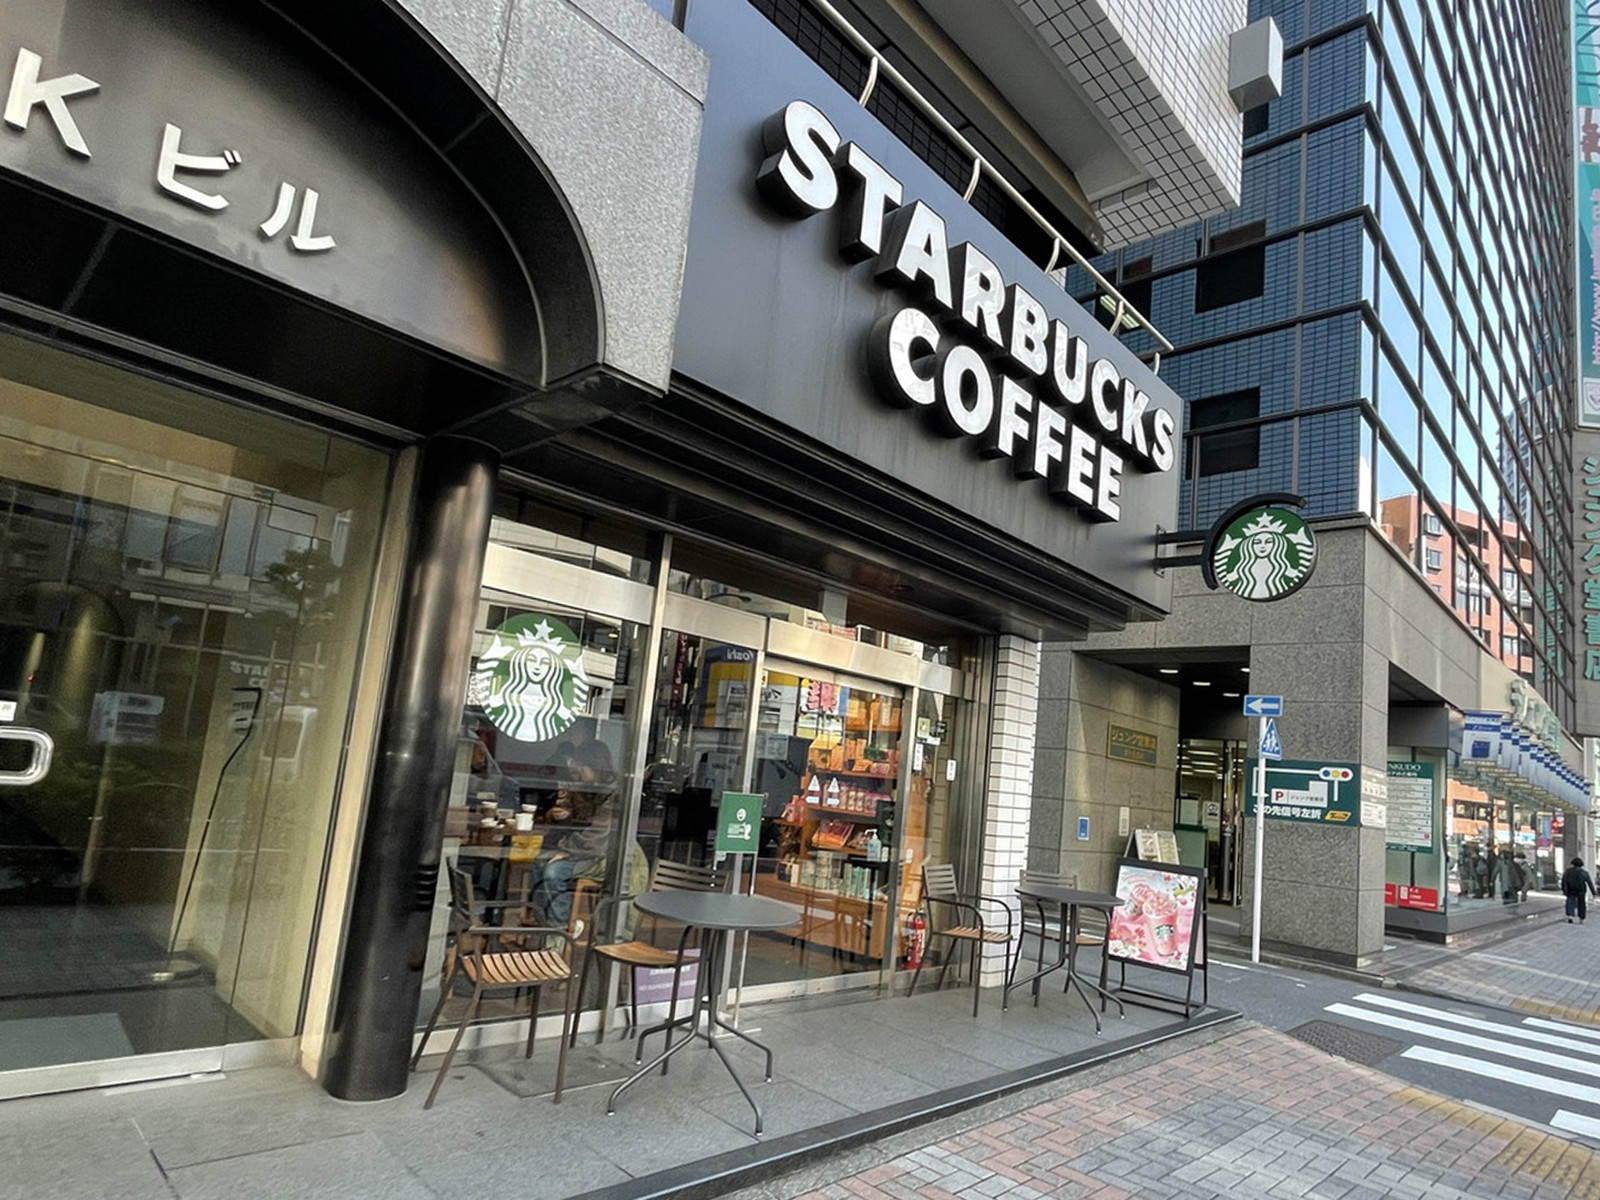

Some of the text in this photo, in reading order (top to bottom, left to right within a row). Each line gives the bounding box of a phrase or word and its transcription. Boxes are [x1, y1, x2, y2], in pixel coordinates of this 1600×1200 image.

[4, 47, 337, 251] K ビル
[773, 100, 1176, 473] STARBUCKS
[887, 306, 1123, 523] COFFEE
[1275, 791, 1284, 801] P
